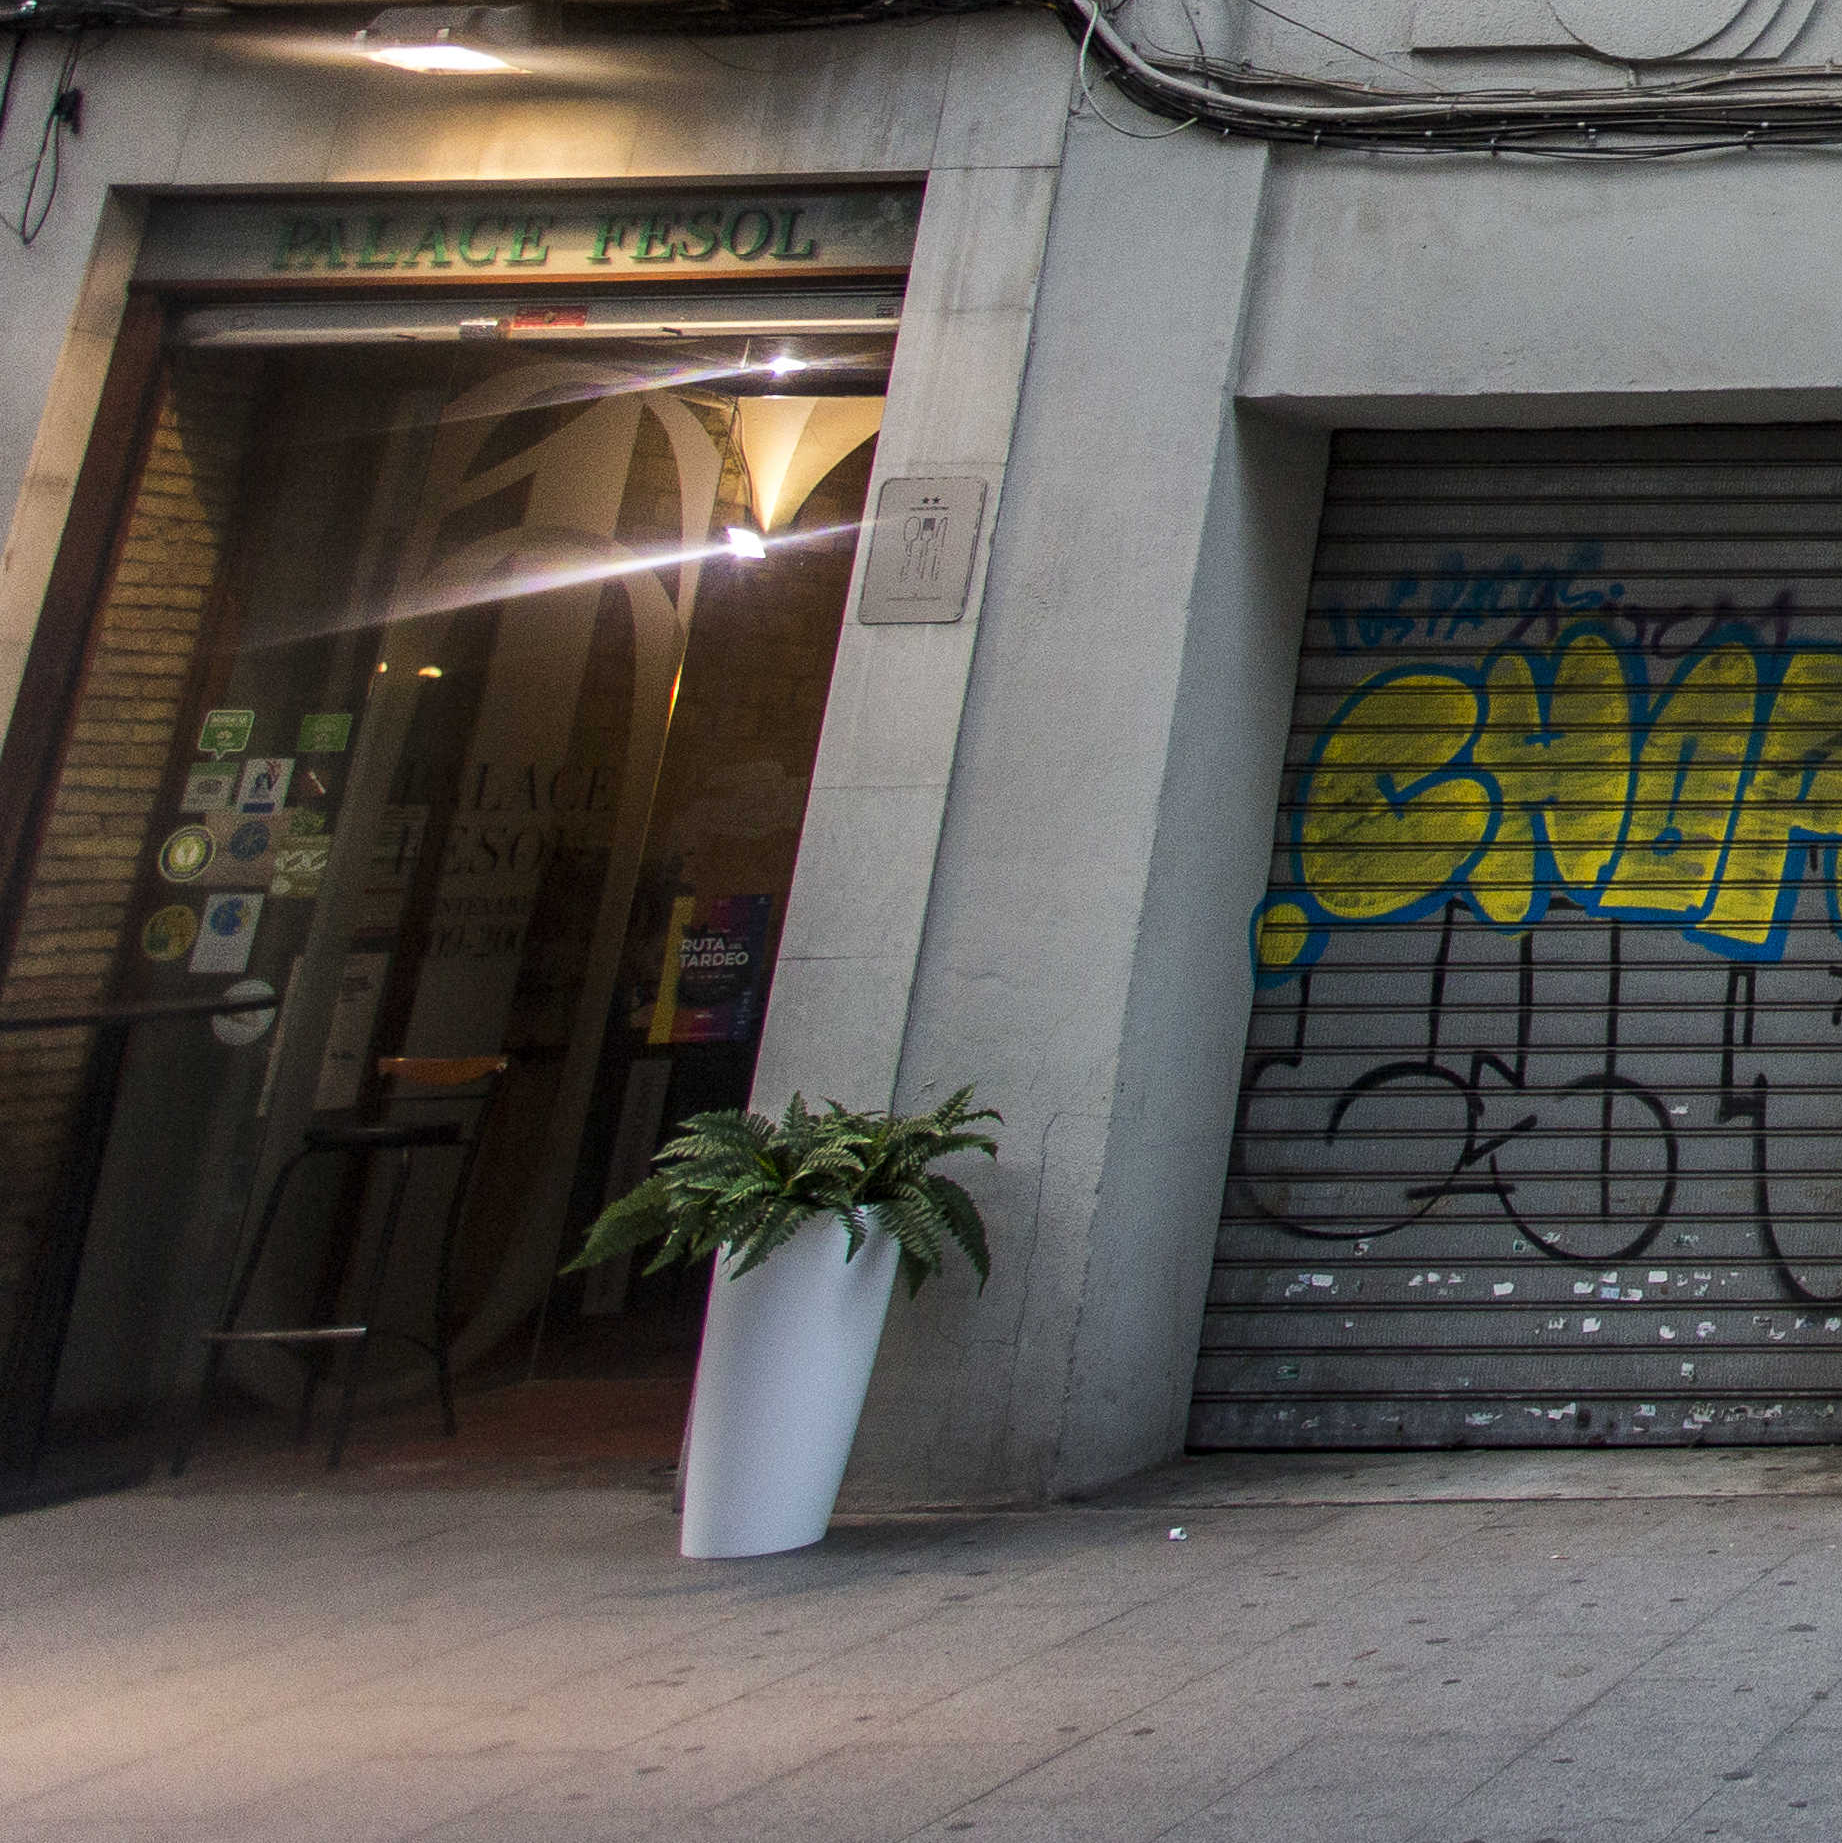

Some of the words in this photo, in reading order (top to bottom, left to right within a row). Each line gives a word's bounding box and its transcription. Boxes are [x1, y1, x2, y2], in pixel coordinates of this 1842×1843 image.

[272, 212, 556, 272] PALACE
[586, 205, 818, 265] FESOL
[680, 936, 726, 953] RUTA
[679, 951, 750, 968] TARDEO
